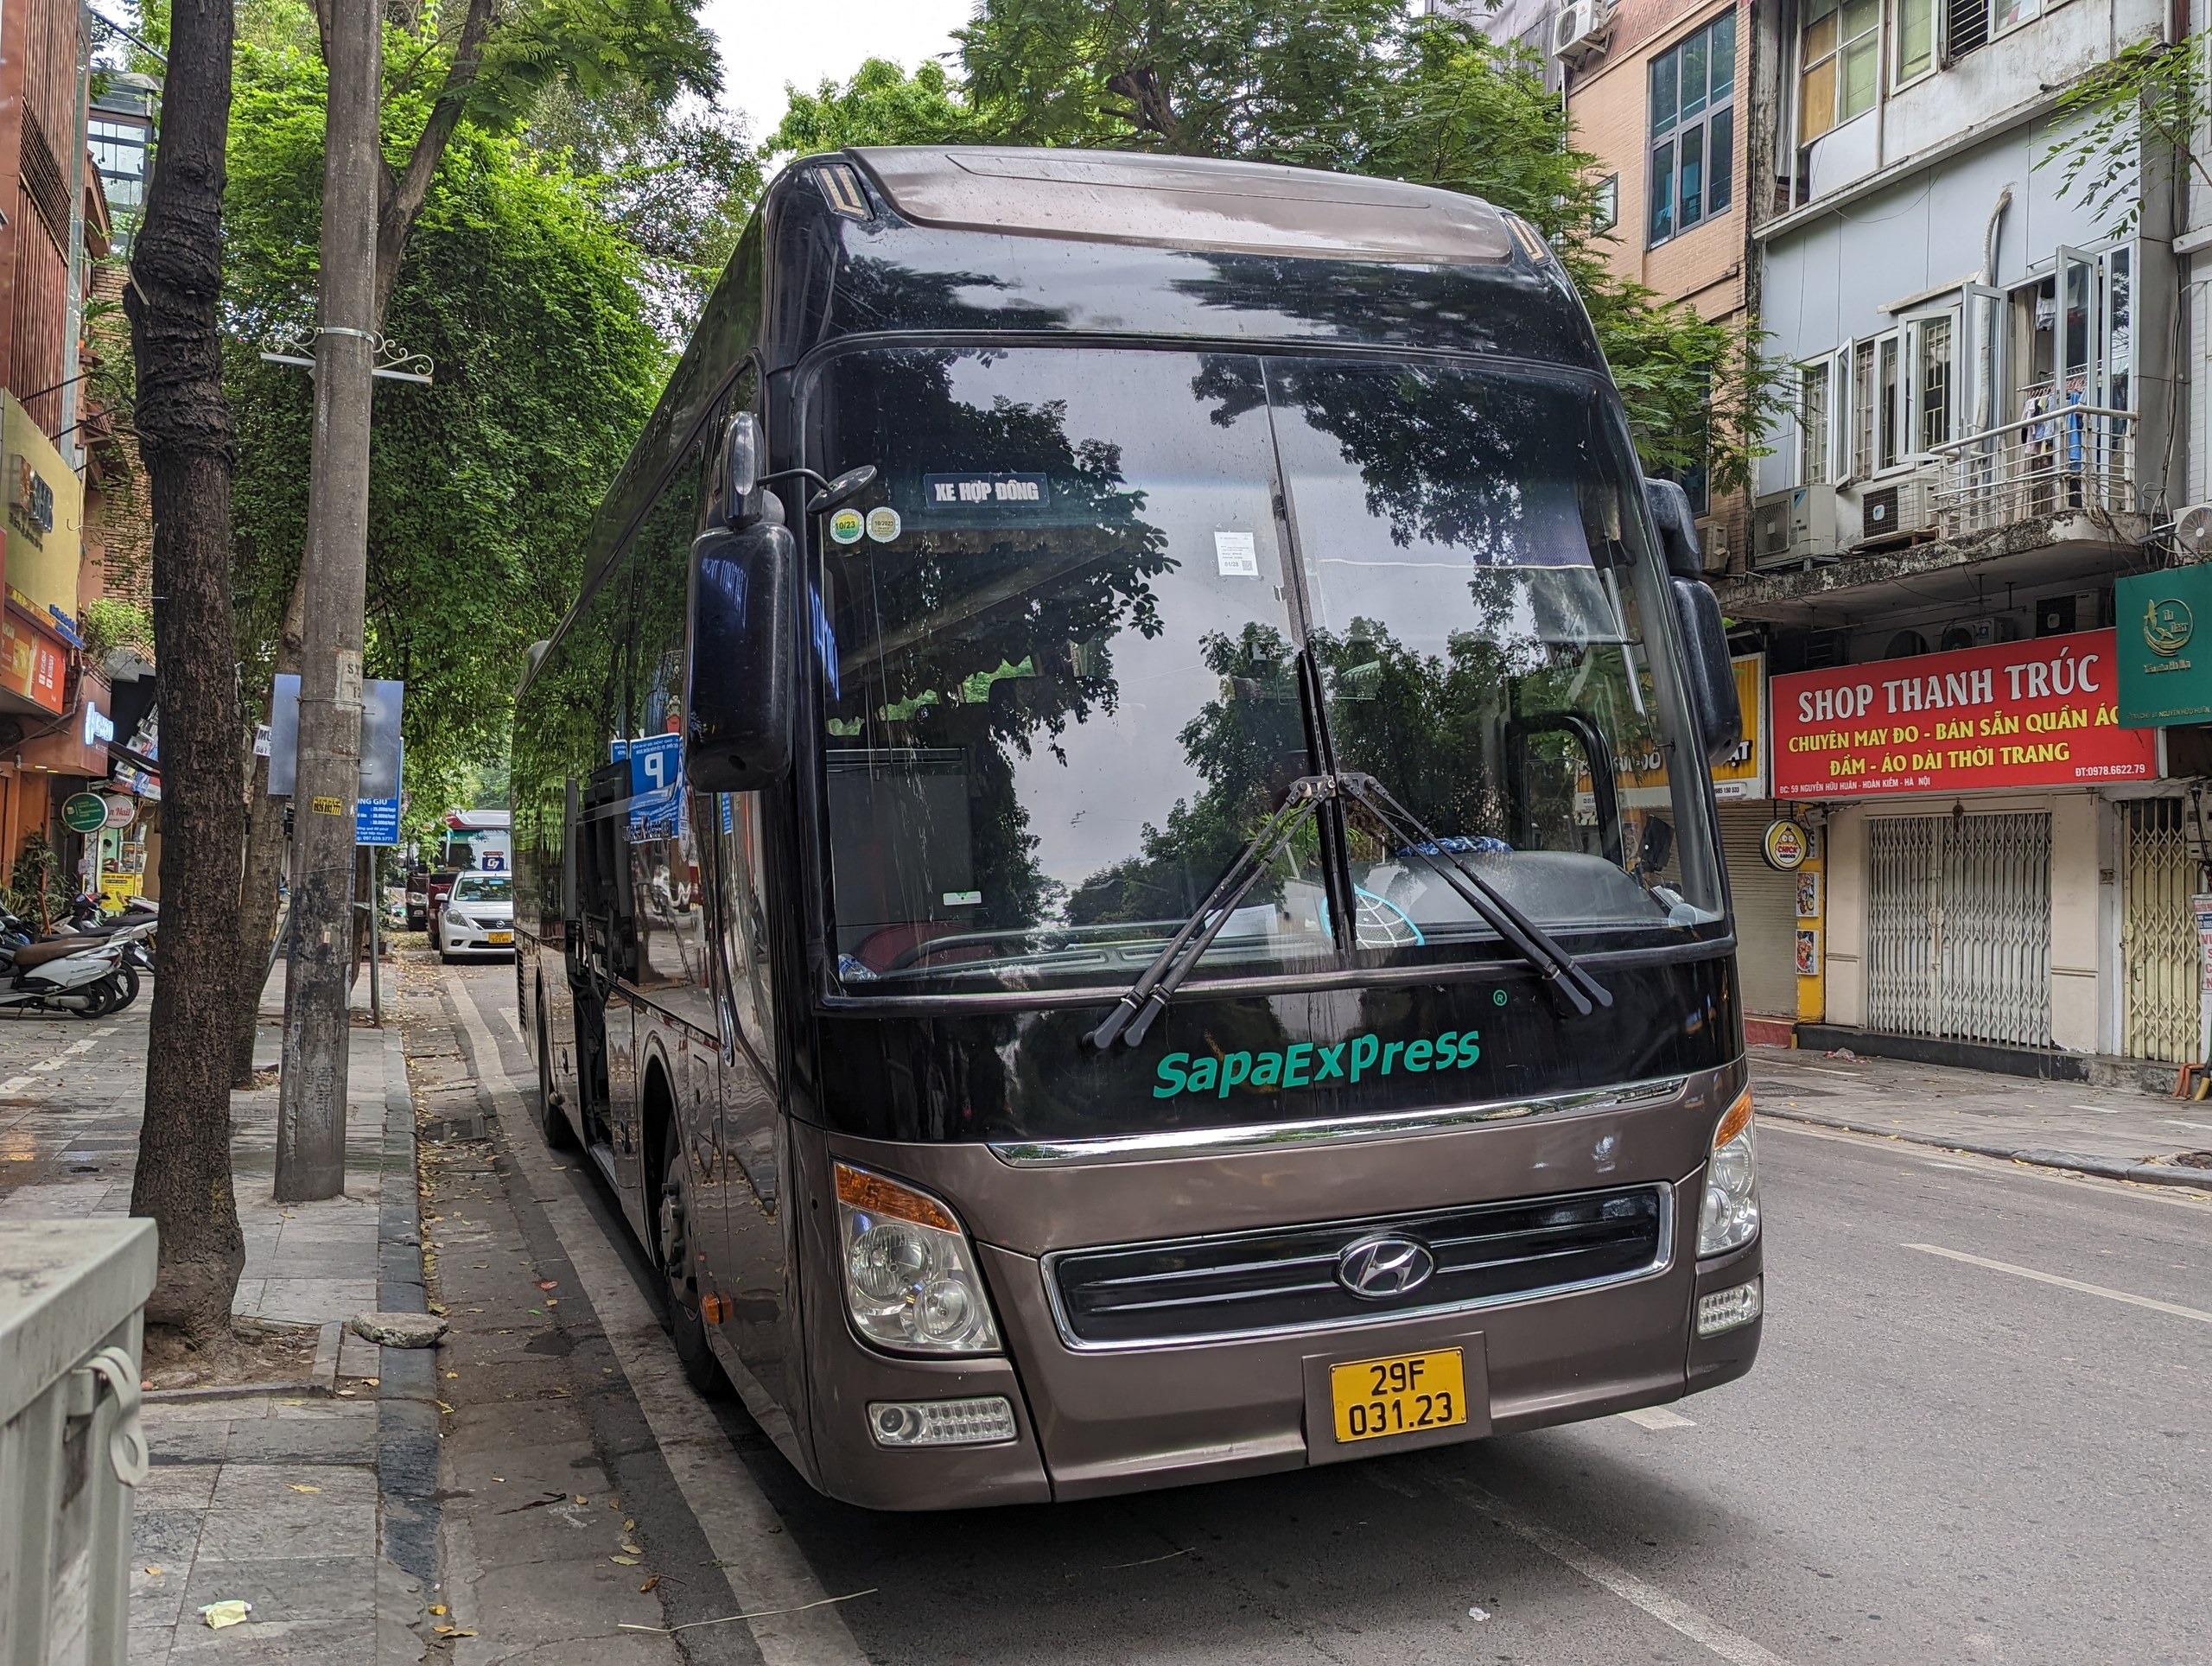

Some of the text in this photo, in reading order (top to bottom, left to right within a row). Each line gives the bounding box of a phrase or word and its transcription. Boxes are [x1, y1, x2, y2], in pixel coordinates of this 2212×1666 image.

[935, 482, 957, 501] XE
[959, 480, 992, 504] HỢP
[835, 521, 855, 530] 10/23
[1798, 645, 2100, 723] SHOP THANH TRÚC
[1789, 730, 1849, 753] CHUYÊN
[1854, 728, 1888, 747] MAY
[1892, 725, 1919, 744] ĐO
[1936, 717, 1974, 741] BÁN
[1980, 710, 2019, 736] SẴN
[2025, 704, 2088, 734] QUẦN
[1829, 754, 1866, 776] ĐẦM
[1880, 752, 1907, 773] ÁO
[1912, 749, 1942, 771] DÀI
[1947, 745, 1994, 768] THỜI
[1999, 742, 2070, 766] TRANG
[2075, 763, 2145, 777] ĐT:0978.6622.79
[1790, 784, 1799, 793] 59
[1862, 779, 1880, 789] HOÀN
[1904, 776, 1914, 787] HÀ
[1918, 775, 1931, 786] NỘI
[1777, 845, 1798, 854] CHICK
[486, 858, 499, 869] G7
[1370, 1358, 1426, 1396] 29F
[1348, 1391, 1453, 1436] 031.23
